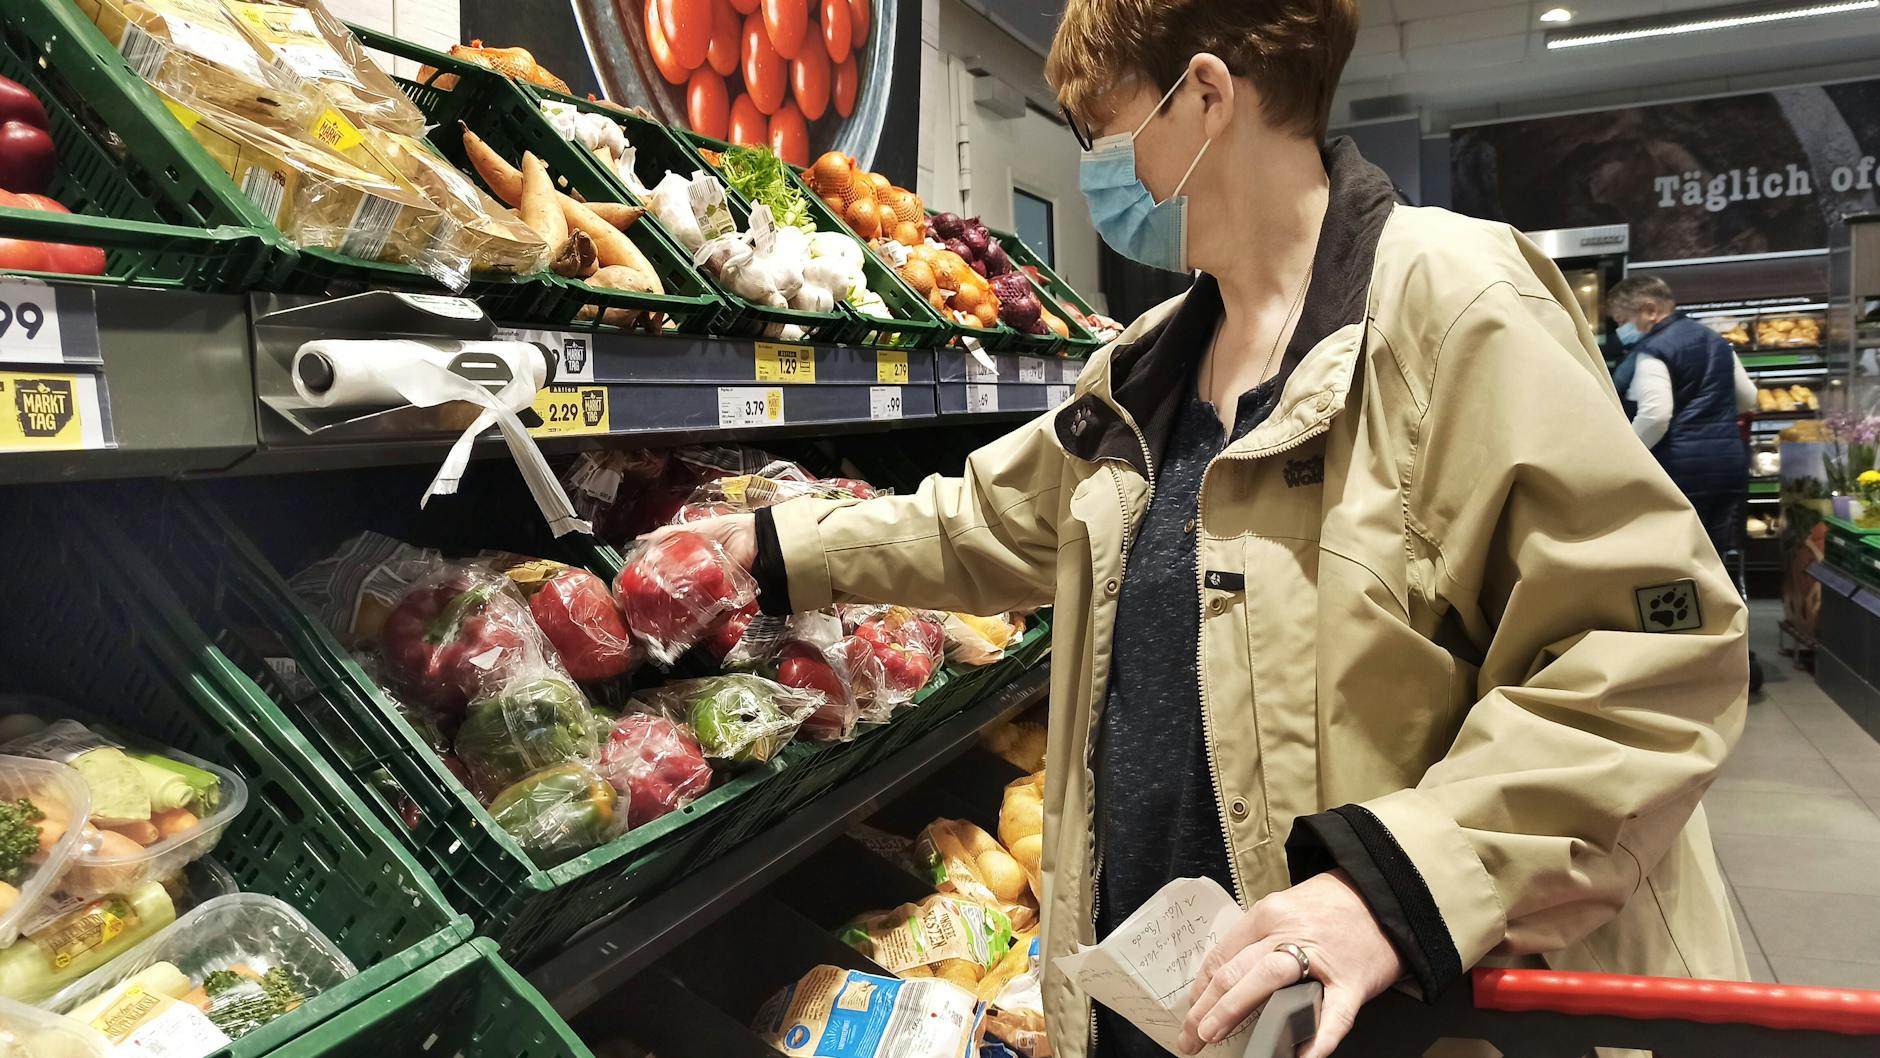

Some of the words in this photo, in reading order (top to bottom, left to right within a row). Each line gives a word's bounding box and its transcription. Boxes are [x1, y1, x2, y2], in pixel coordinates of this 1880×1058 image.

[1654, 163, 1812, 212] Täglich
[1831, 155, 1880, 192] of
[779, 358, 797, 375] 1.29
[23, 393, 66, 414] MARKT
[745, 400, 765, 416] 3.79
[29, 413, 57, 431] TAG
[549, 404, 578, 422] 2.29
